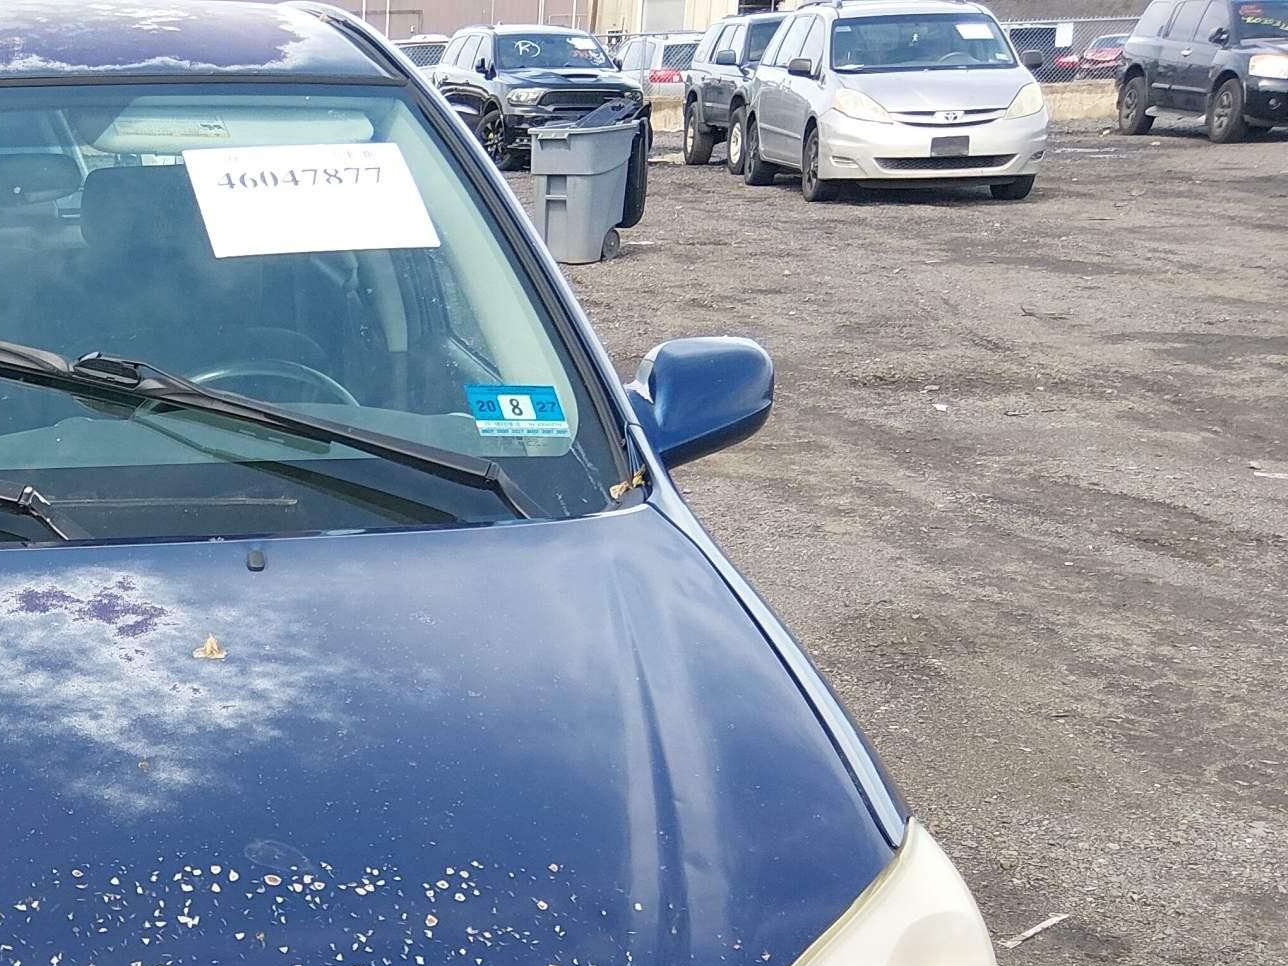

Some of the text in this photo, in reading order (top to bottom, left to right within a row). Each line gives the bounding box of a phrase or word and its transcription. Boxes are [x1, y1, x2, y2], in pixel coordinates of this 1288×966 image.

[217, 167, 381, 190] 46047877
[475, 398, 557, 416] 20 8 27
